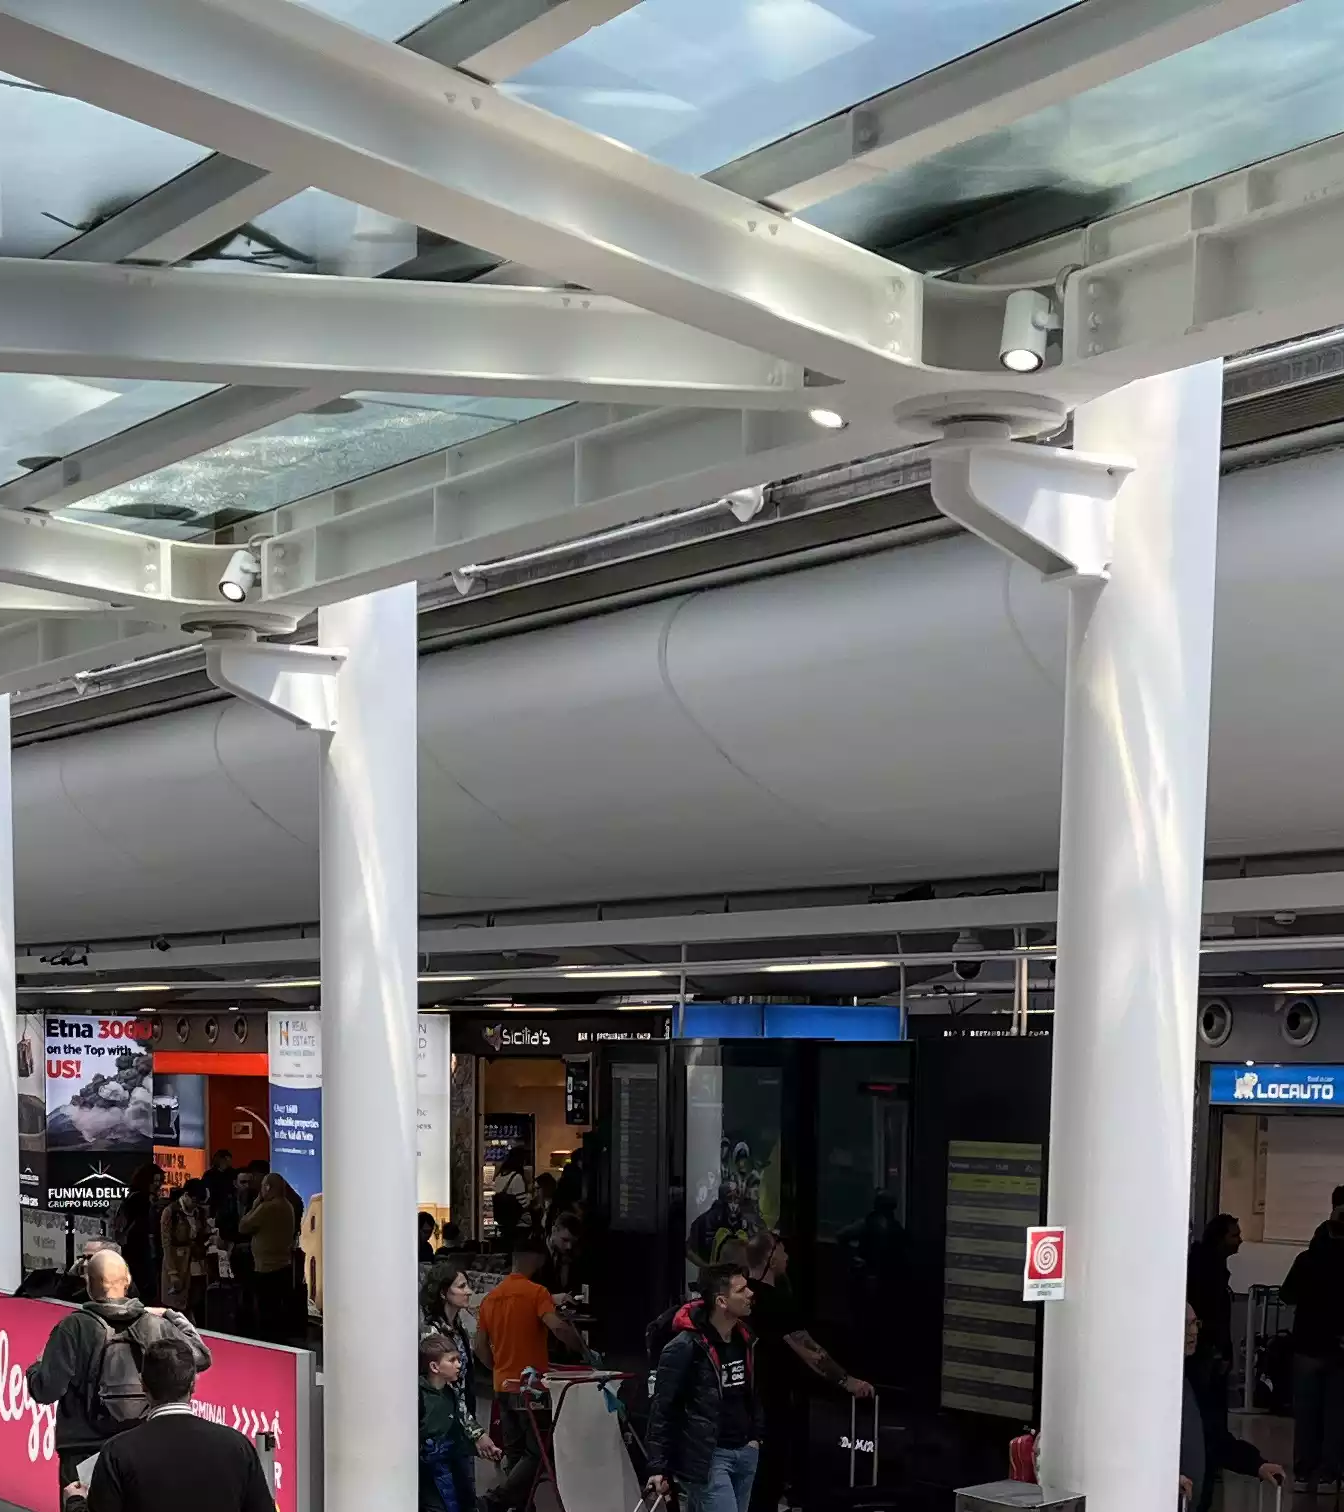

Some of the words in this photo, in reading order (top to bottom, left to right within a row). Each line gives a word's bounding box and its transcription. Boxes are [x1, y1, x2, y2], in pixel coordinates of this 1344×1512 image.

[46, 1019, 93, 1038] Etna
[98, 1020, 153, 1040] 3000
[292, 1021, 308, 1032] REAL
[292, 1036, 316, 1047] ESTATE
[502, 1026, 551, 1045] Sicilia's
[47, 1046, 60, 1054] on
[63, 1044, 81, 1054] the
[85, 1045, 105, 1057] Top
[108, 1046, 132, 1056] with
[47, 1060, 81, 1078] US!
[1257, 1083, 1334, 1100] LOCAUTO
[48, 1188, 93, 1199] FUNIVIA
[48, 1200, 80, 1208] GRUPPO
[82, 1200, 109, 1208] RUSSO
